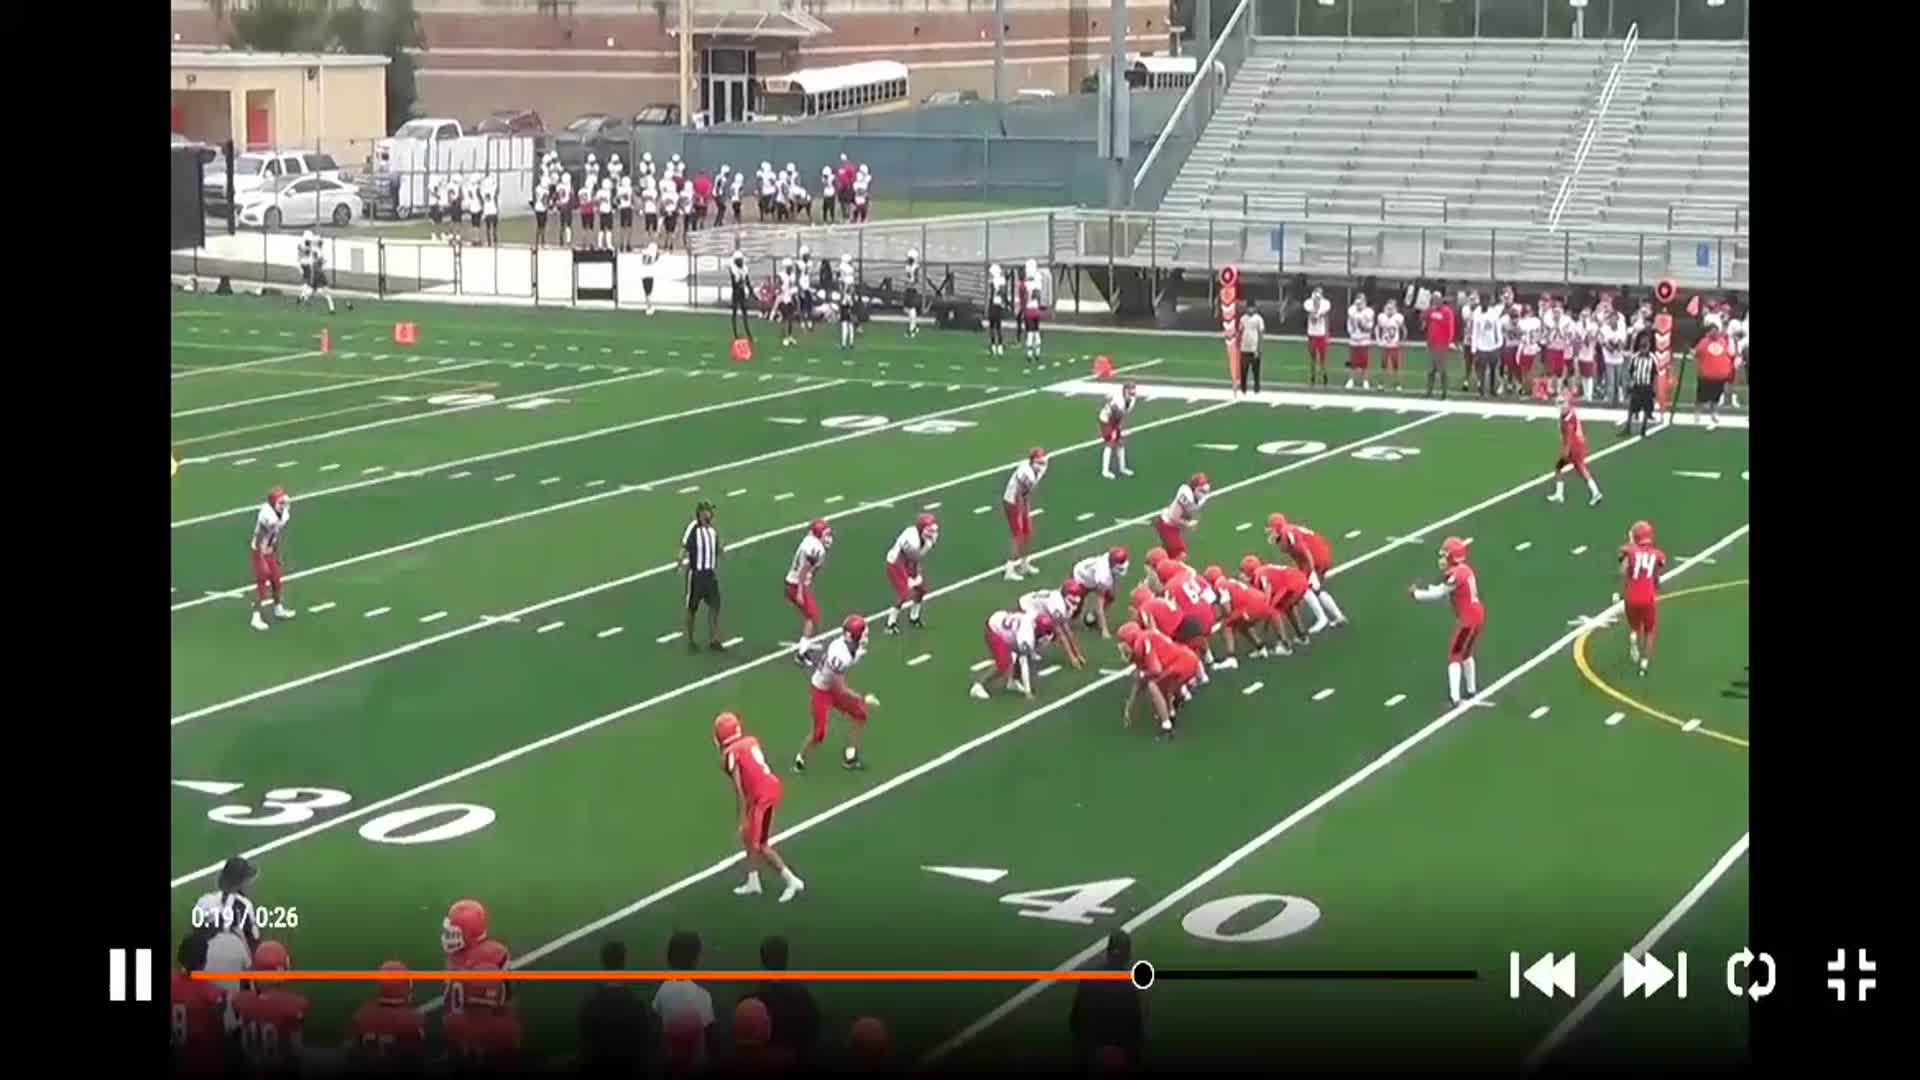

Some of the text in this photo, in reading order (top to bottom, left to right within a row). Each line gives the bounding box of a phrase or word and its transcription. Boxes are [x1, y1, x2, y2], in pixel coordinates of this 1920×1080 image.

[1633, 551, 1657, 580] 14
[207, 787, 497, 844] 30
[998, 877, 1322, 943] 40
